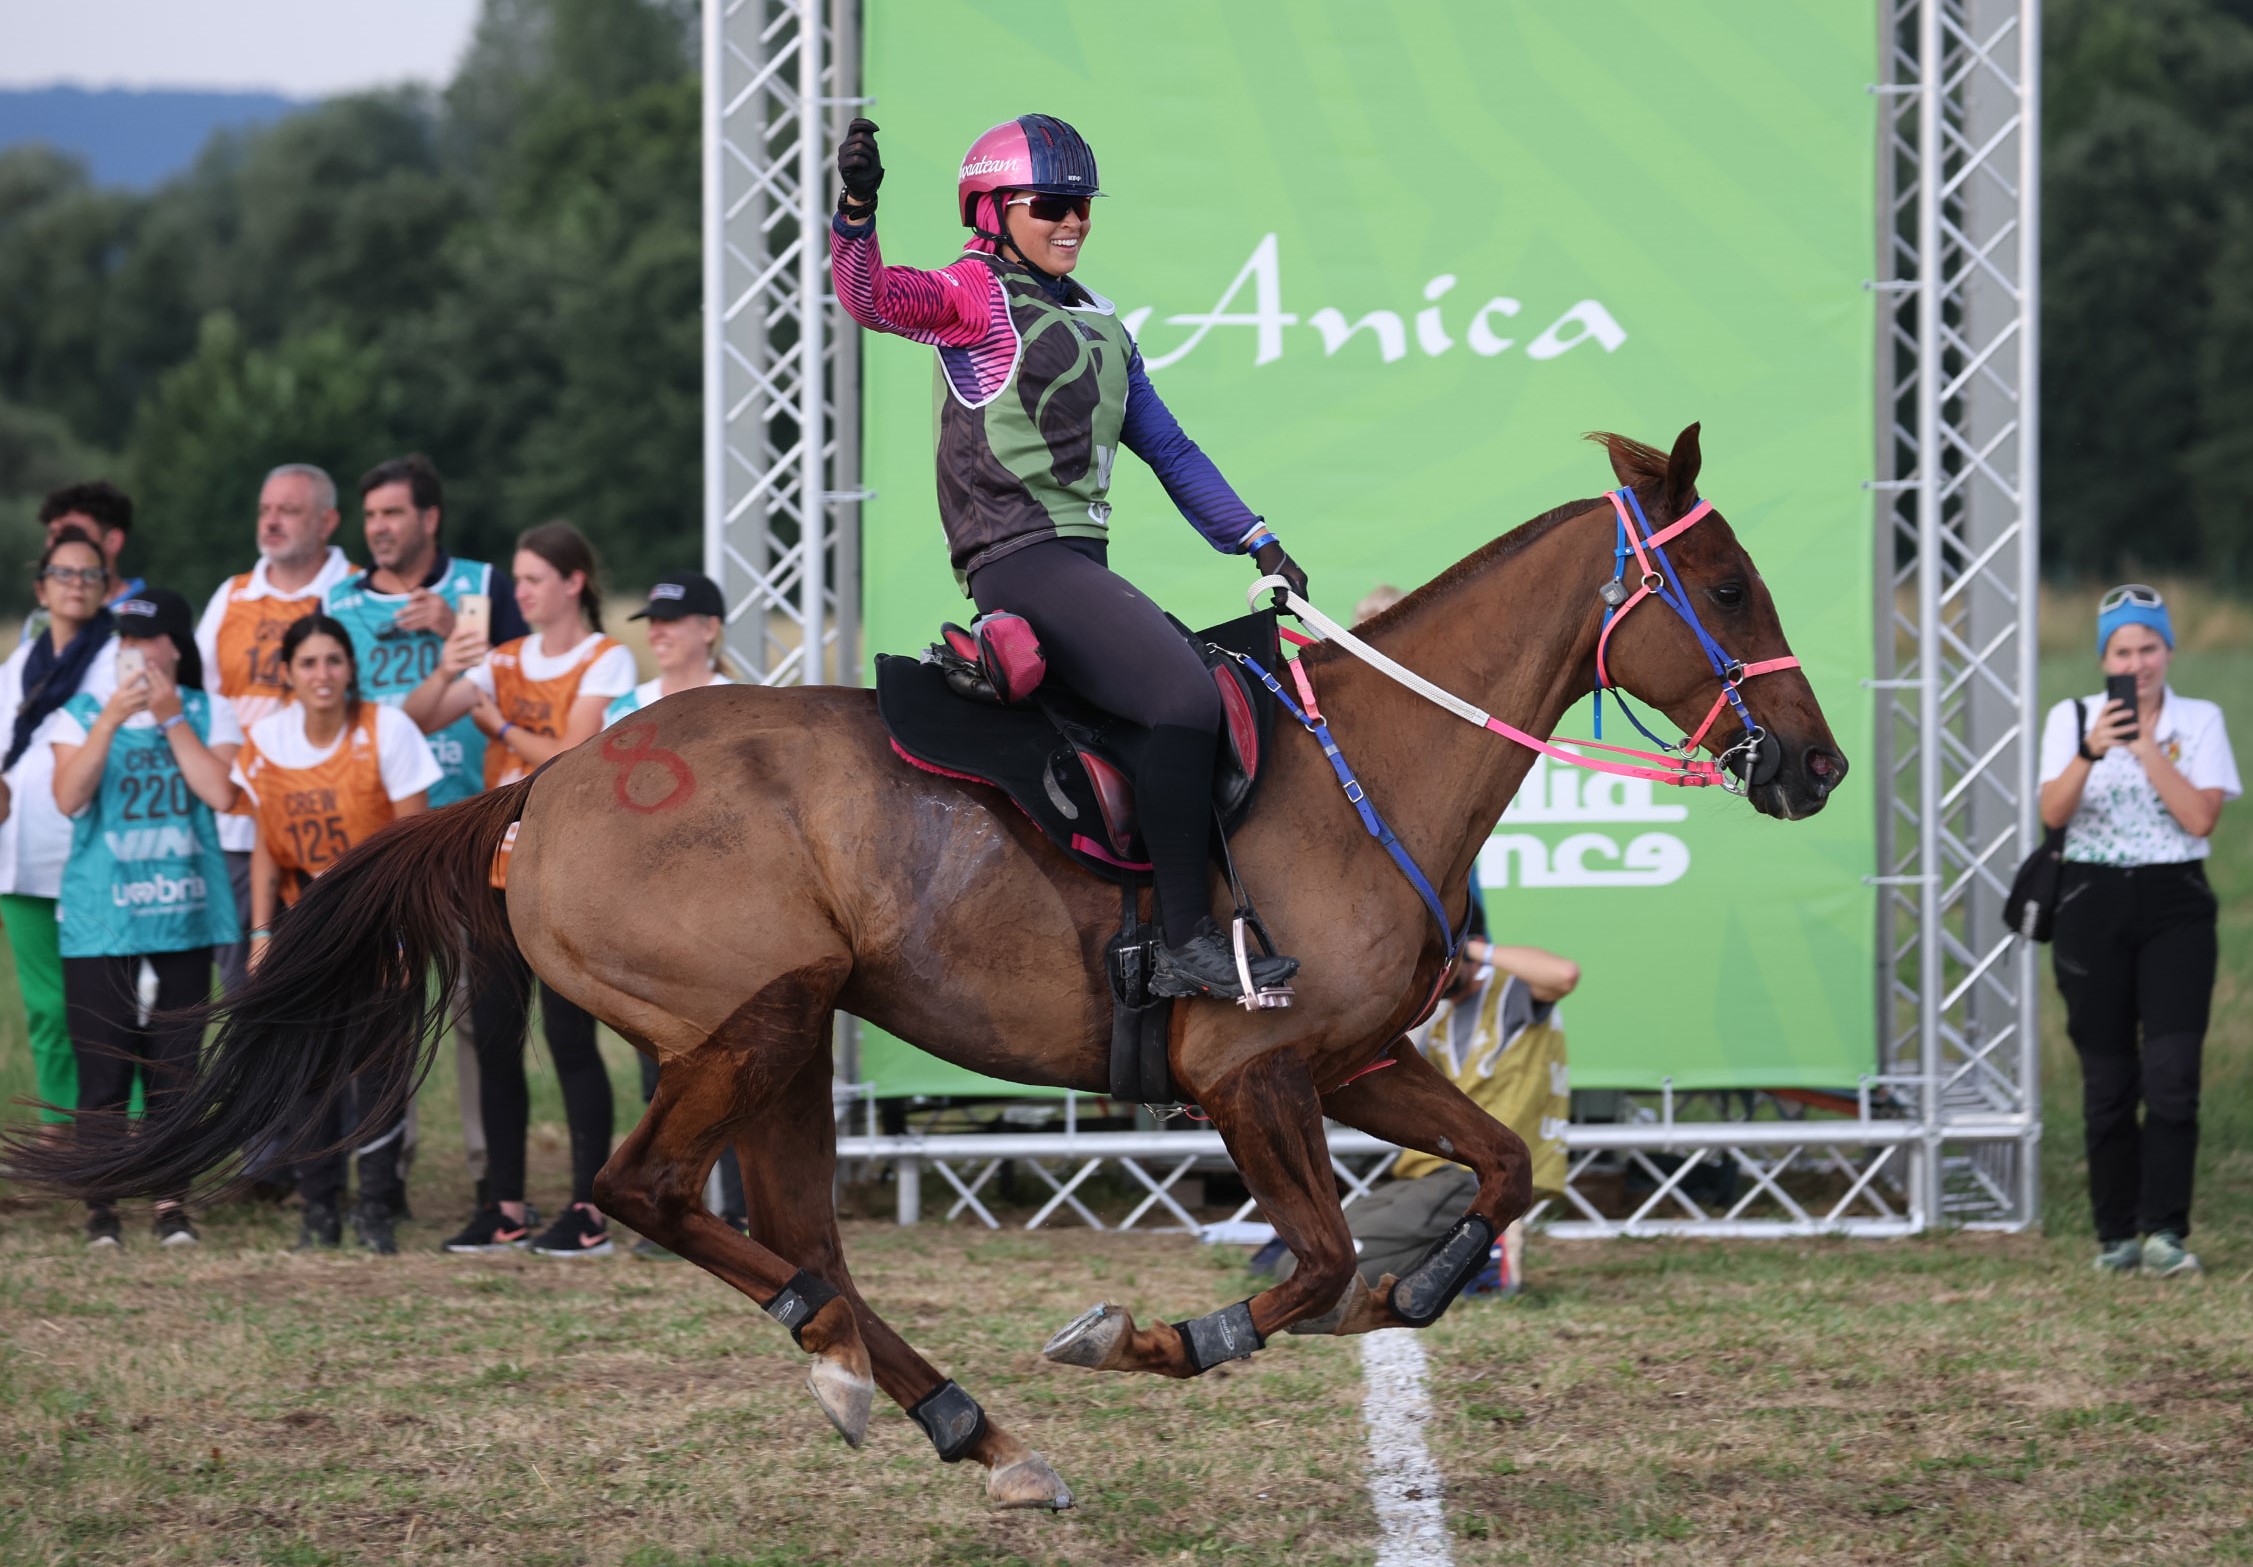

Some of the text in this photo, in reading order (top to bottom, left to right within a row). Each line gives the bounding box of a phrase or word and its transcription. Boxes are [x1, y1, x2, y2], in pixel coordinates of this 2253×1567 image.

[1122, 232, 1628, 371] Anica
[369, 640, 439, 687] 220
[602, 722, 698, 814] 8
[1497, 744, 1689, 823] lia
[120, 772, 191, 820] 220
[286, 816, 349, 864] 125
[1478, 833, 1691, 888] nce
